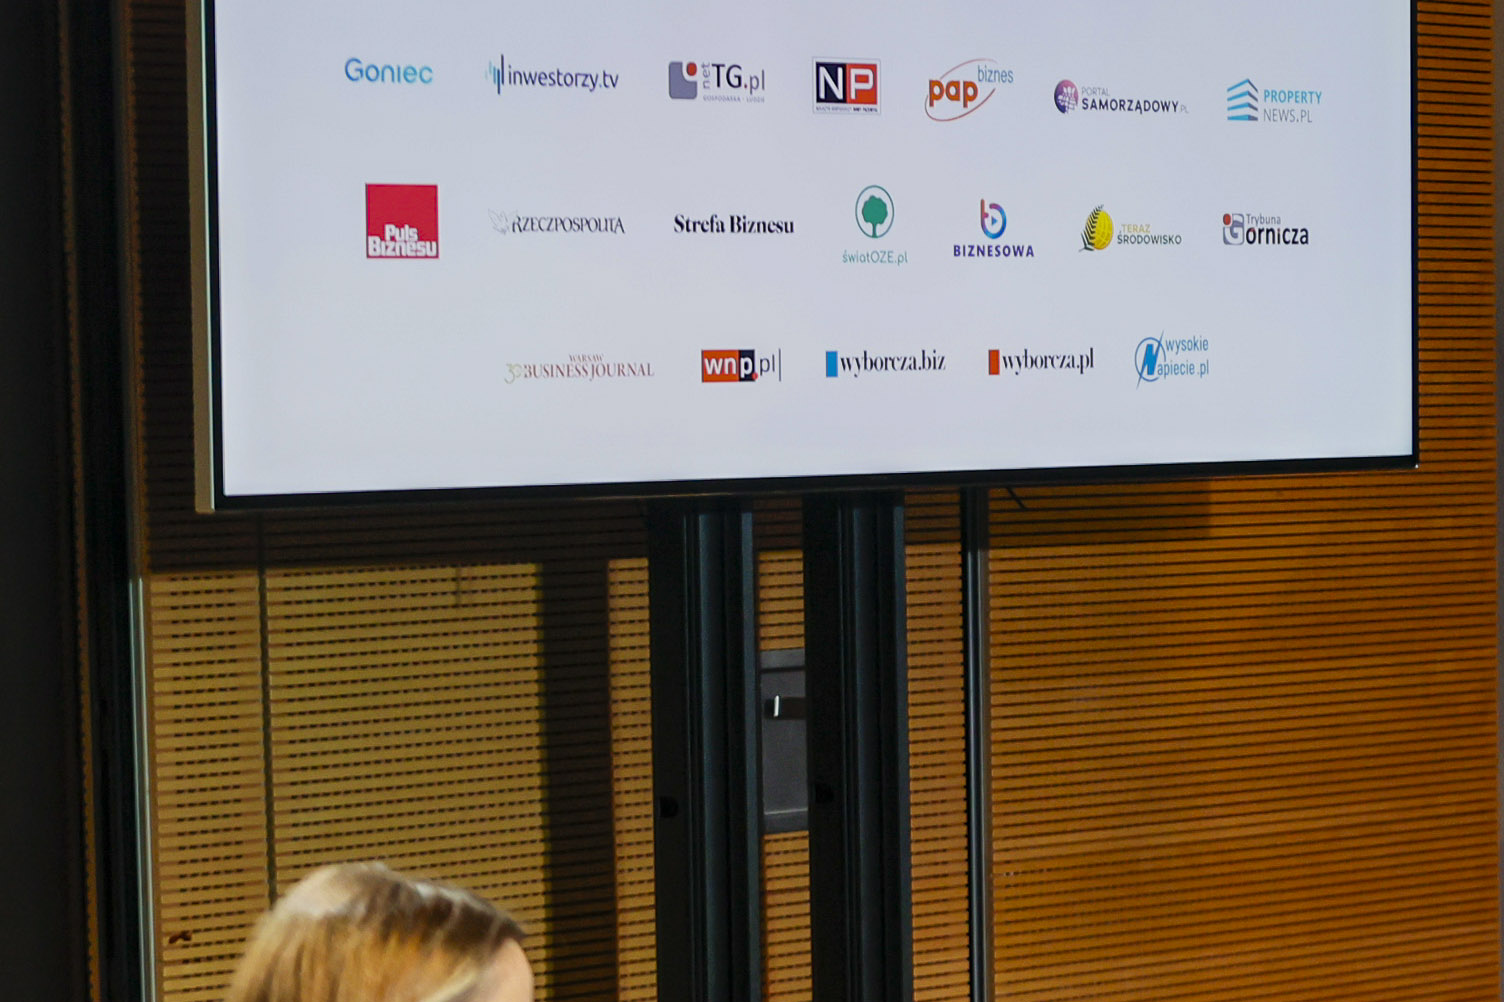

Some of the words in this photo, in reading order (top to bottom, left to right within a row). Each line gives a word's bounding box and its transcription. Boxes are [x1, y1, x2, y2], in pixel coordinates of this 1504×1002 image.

[344, 57, 433, 84] Goniec
[508, 64, 619, 92] inwestorzy.tv
[977, 65, 1014, 84] biznes
[928, 79, 979, 108] pap
[1081, 86, 1109, 97] PORTAL
[1263, 89, 1322, 104] PROPERTY
[1263, 108, 1313, 123] NEWS.PL
[673, 214, 726, 234] Strefa
[729, 215, 795, 234] Biznesu
[1122, 224, 1150, 233] TERAZ
[1246, 213, 1281, 226] Trybuna
[384, 224, 418, 242] Puls
[1117, 232, 1182, 245] ŚRODOWISKO
[367, 236, 437, 257] Biznesu
[953, 244, 1035, 258] BIZNESOWA
[1165, 335, 1209, 355] wysokie
[569, 353, 604, 363] WARSAW
[839, 349, 946, 378] wyborcza.biz
[1002, 347, 1094, 376] wyborcza.pl
[589, 362, 655, 381] JOURNAL
